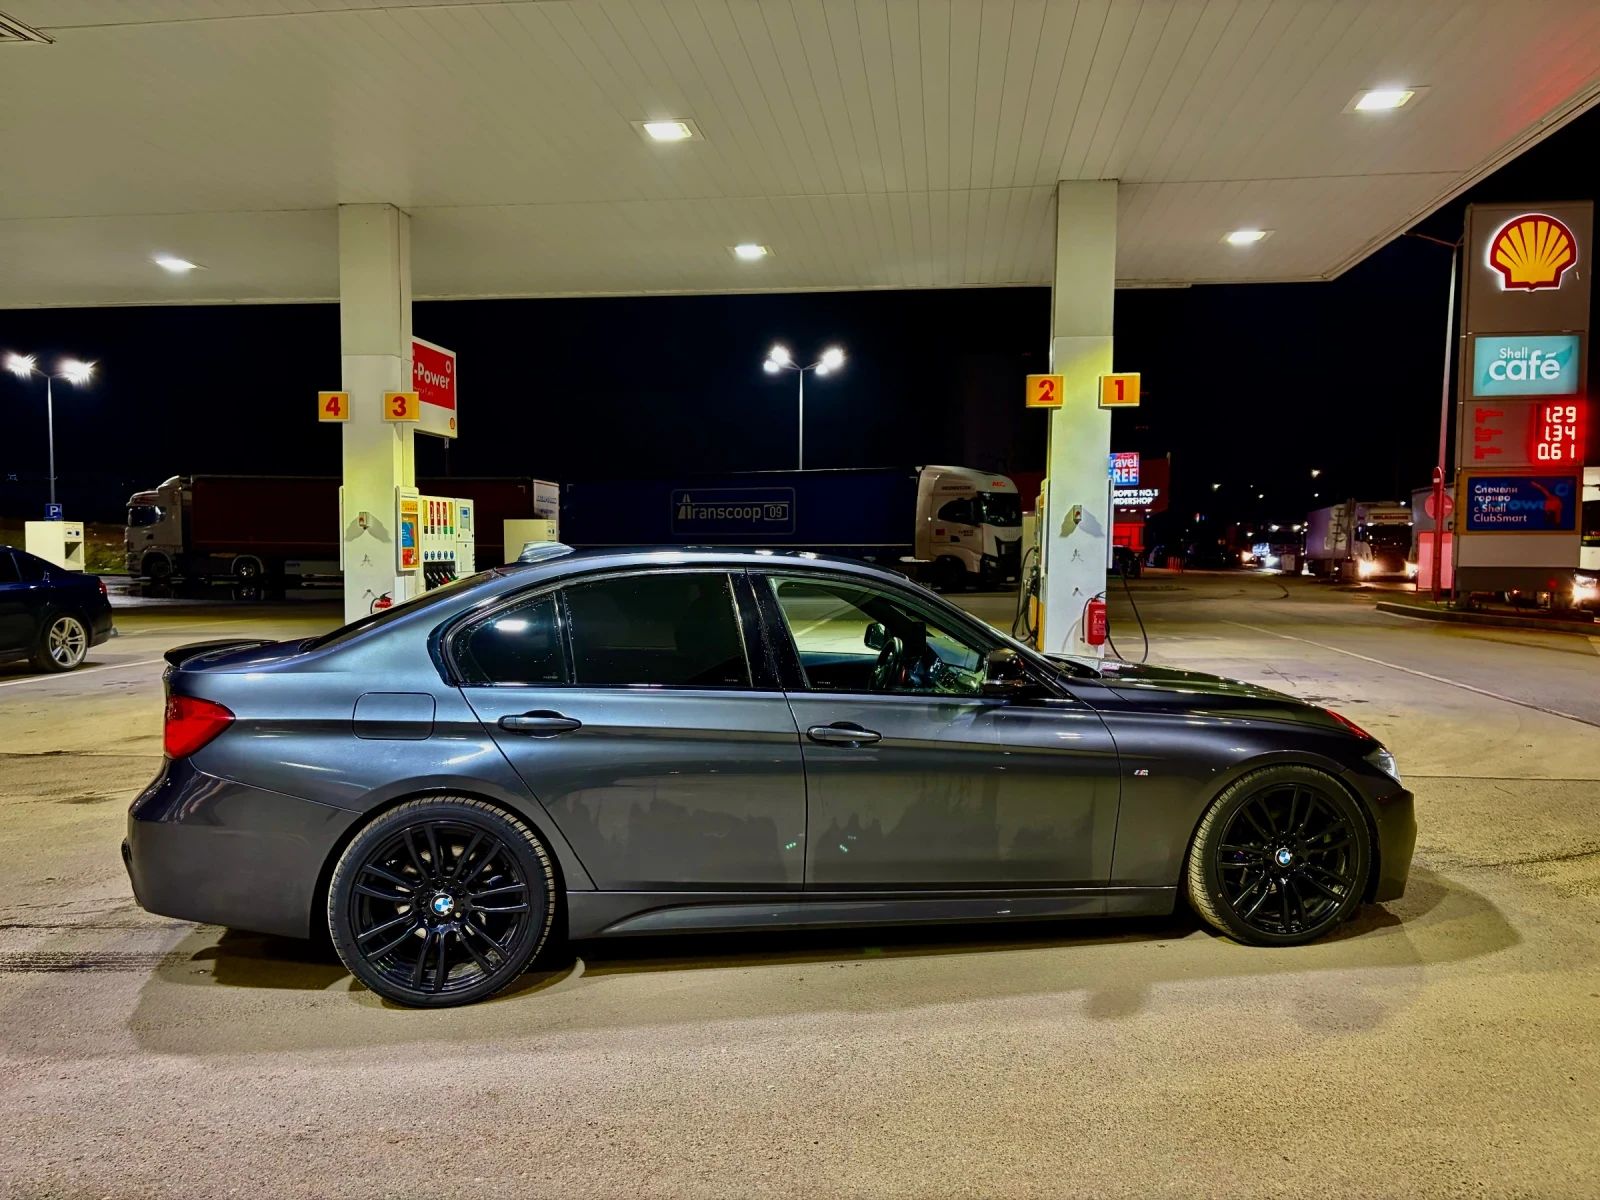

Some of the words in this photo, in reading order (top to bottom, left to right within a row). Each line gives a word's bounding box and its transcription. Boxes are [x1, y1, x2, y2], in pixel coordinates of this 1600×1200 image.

[1499, 347, 1528, 359] Shell
[412, 361, 450, 389] -Power
[1488, 350, 1560, 381] café
[1038, 379, 1055, 401] 2
[1114, 379, 1125, 401] 1
[325, 396, 341, 417] 4
[392, 395, 407, 417] 3
[1474, 485, 1518, 494] Спечели
[1474, 495, 1511, 504] гориво
[50, 505, 59, 516] P
[676, 499, 762, 523] Transcoop
[1473, 513, 1528, 523] ClubSmart
[1481, 503, 1506, 513] Shell
